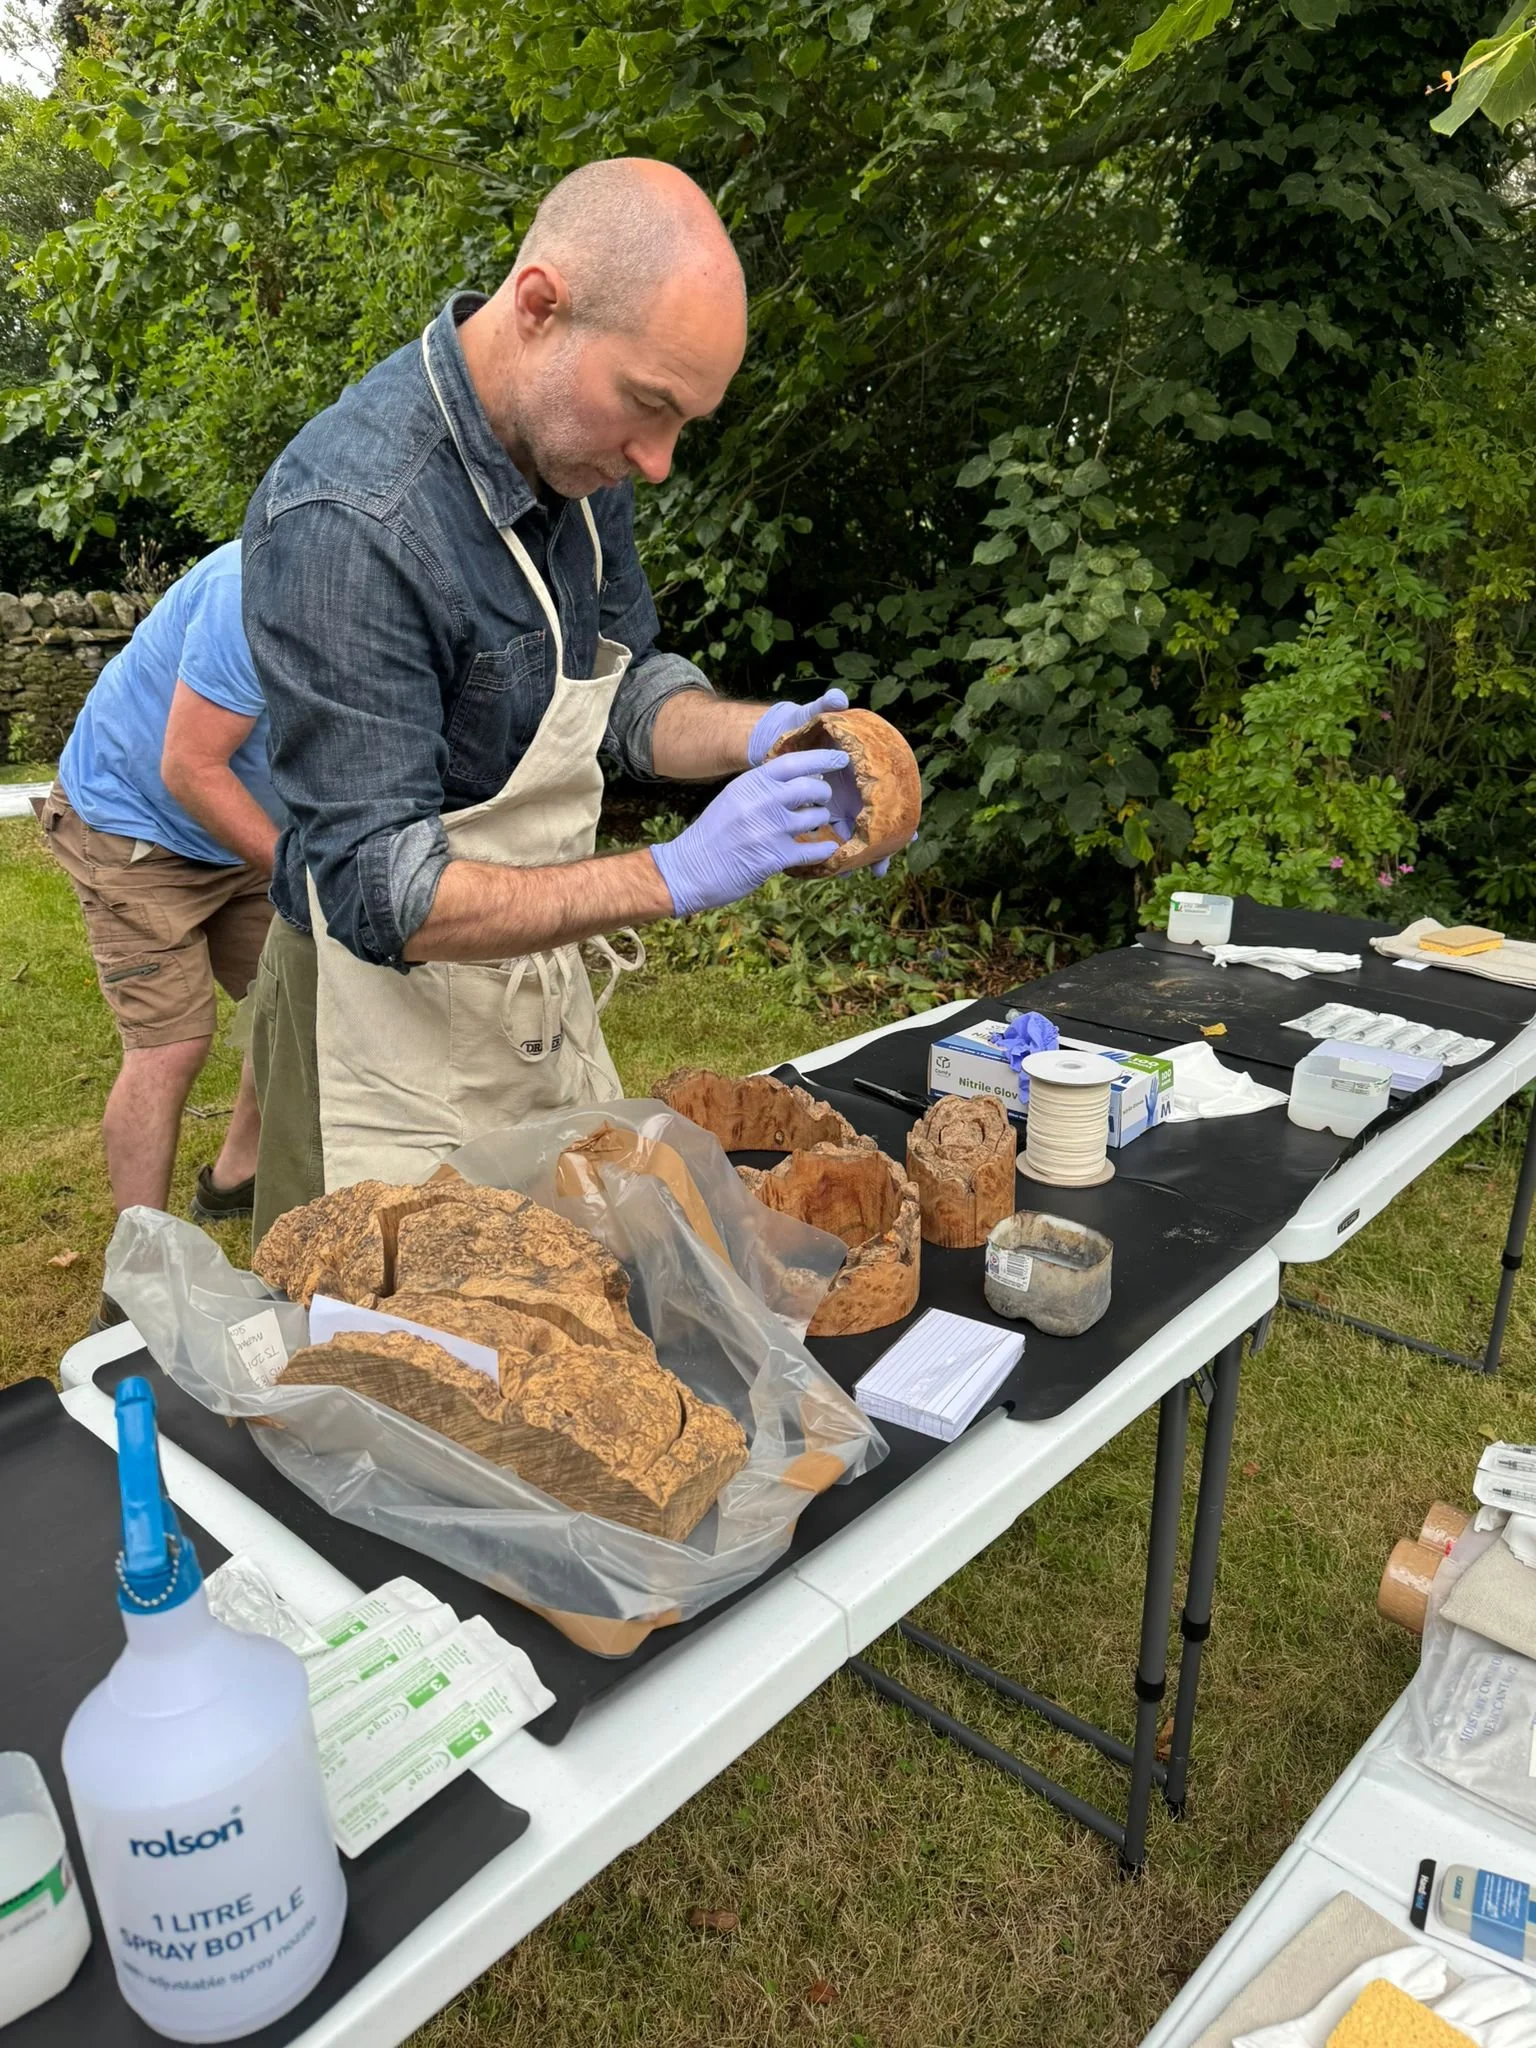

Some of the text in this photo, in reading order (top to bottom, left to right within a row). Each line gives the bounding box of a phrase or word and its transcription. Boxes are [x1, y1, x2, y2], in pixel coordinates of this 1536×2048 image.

[526, 1038, 561, 1053] DRER
[959, 1077, 1018, 1100] Nitrile Glov
[1160, 1101, 1171, 1118] M
[430, 1679, 444, 1693] 3
[470, 1726, 486, 1742] 3
[130, 1817, 244, 1858] rolson
[120, 1885, 305, 1961] SPRAY BOTTLE
[152, 1893, 255, 1933] 1 LITRE
[230, 1953, 276, 1985] spray
